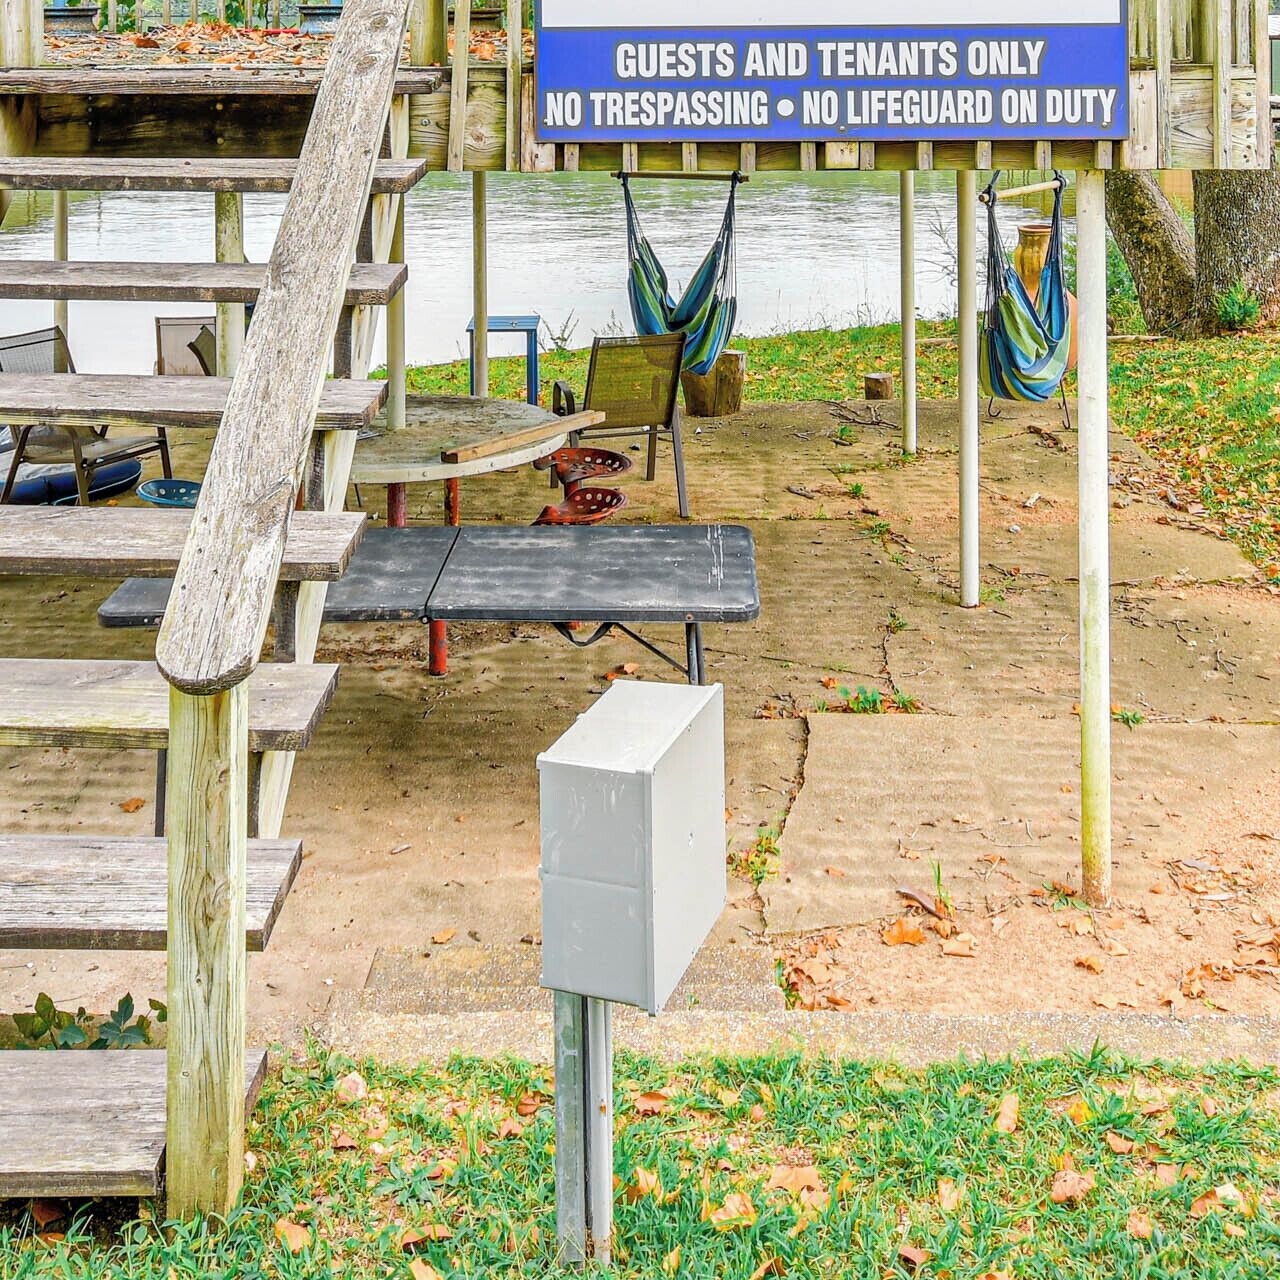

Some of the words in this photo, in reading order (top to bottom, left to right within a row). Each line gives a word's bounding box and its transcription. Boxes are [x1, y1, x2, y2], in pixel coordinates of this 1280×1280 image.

[616, 42, 735, 78] GUESTS
[744, 42, 807, 76] AND
[817, 41, 958, 76] TENANTS
[967, 40, 1045, 75] ONLY
[546, 91, 582, 126] NO
[589, 90, 769, 126] TRESPASSING
[802, 90, 839, 125] NO
[846, 89, 993, 125] LIFEGUARD
[1001, 88, 1039, 124] ON
[1046, 87, 1117, 124] DUTY
